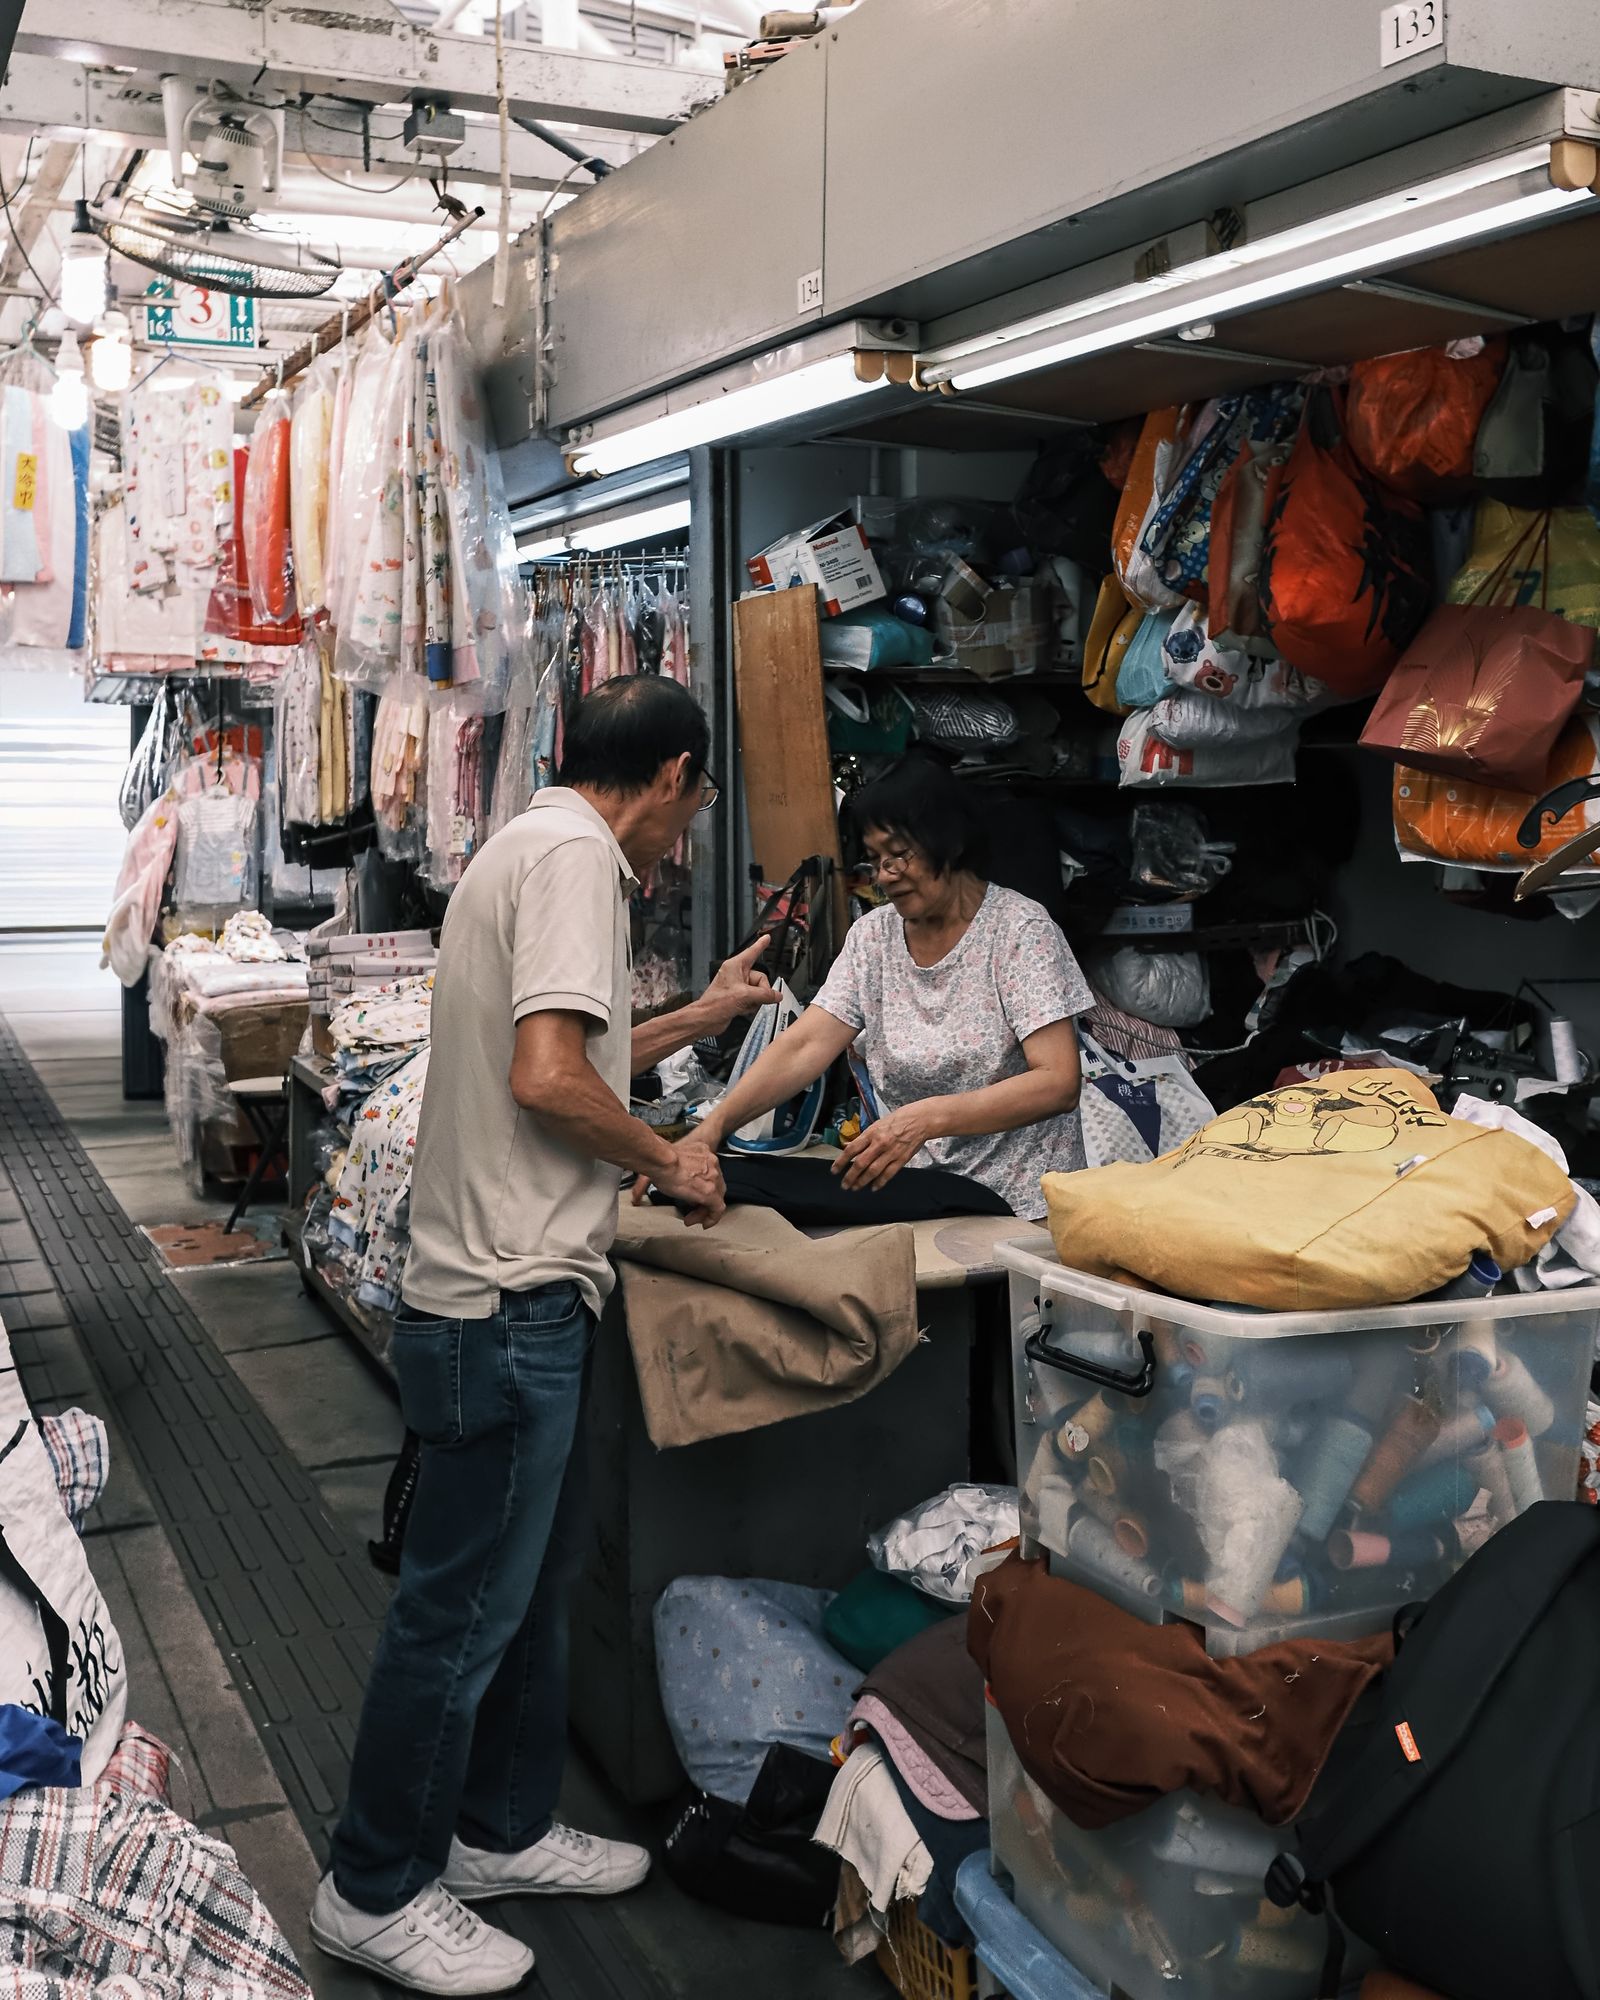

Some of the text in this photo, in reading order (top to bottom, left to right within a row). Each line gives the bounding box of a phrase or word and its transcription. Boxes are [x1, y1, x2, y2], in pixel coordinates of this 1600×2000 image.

[1393, 1, 1435, 49] 133
[802, 276, 819, 304] 134
[189, 287, 213, 324] 3
[231, 326, 254, 342] 113
[812, 537, 839, 551] National
